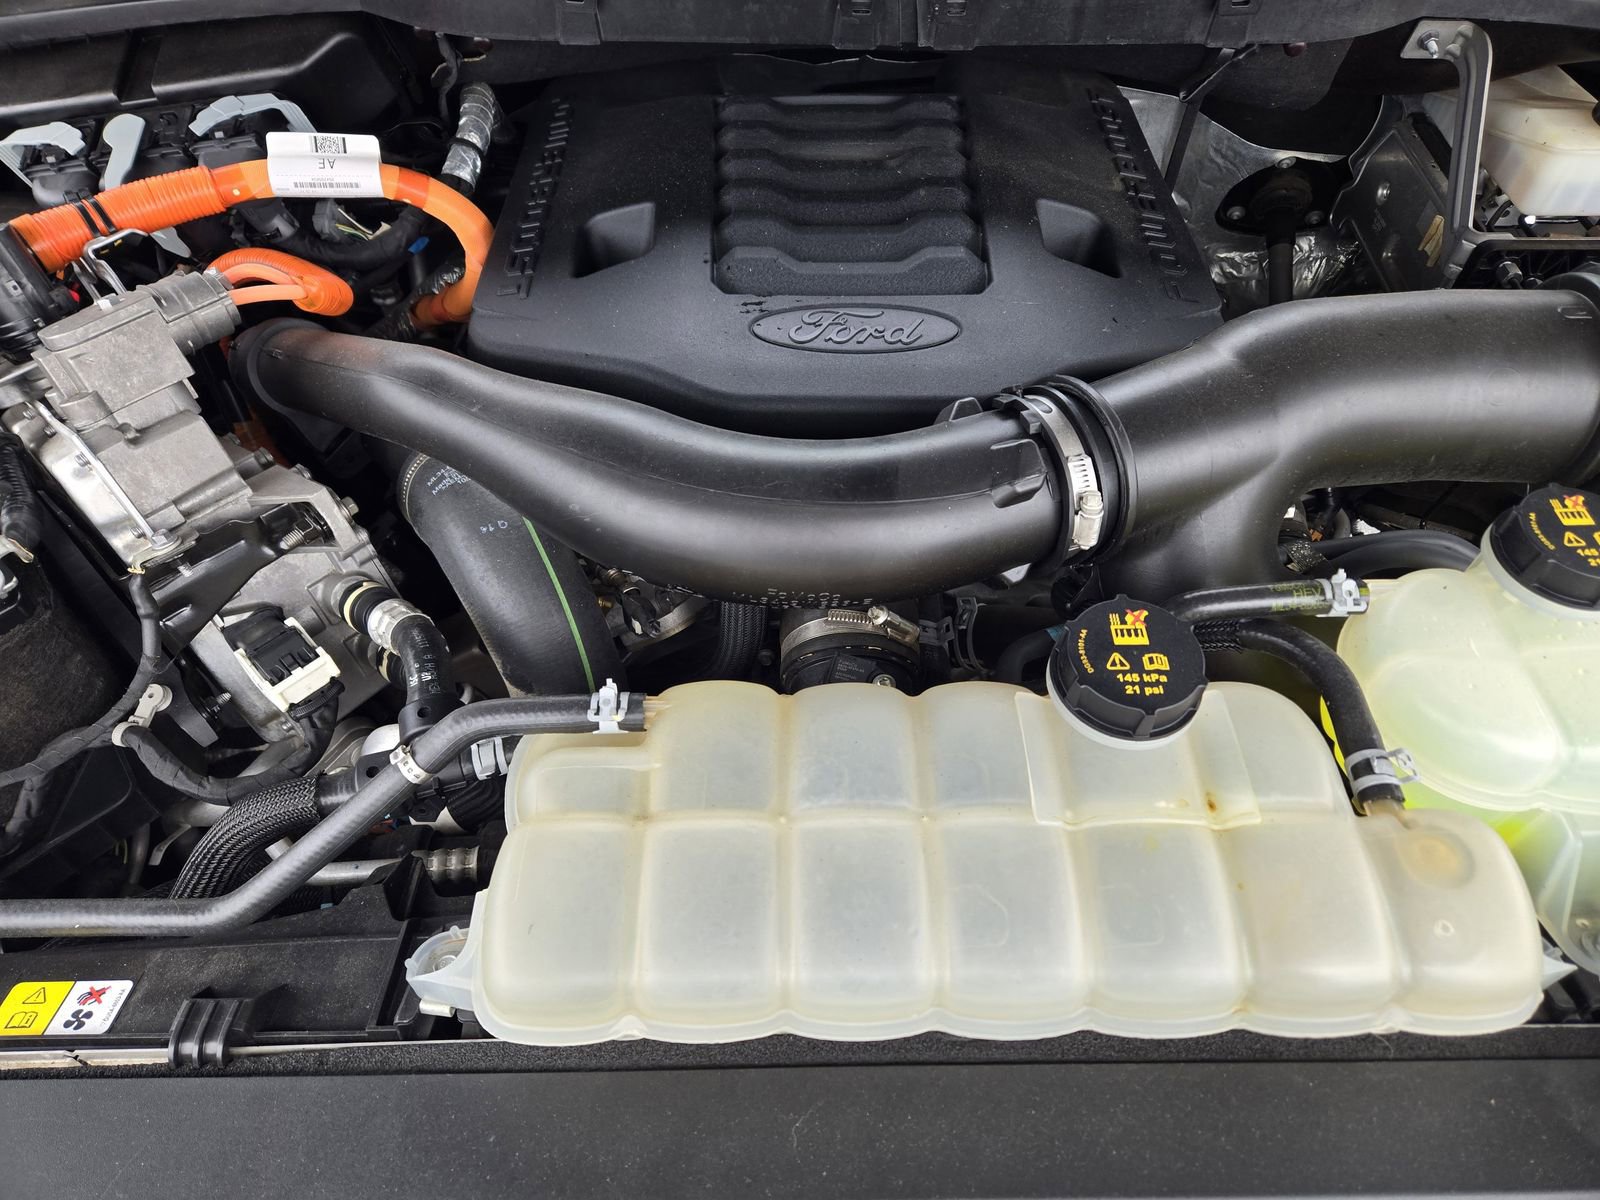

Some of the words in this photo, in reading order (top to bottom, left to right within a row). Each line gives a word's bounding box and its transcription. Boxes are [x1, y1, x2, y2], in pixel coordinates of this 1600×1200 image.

[788, 310, 925, 345] Ford
[1116, 673, 1140, 683] 145
[1142, 673, 1168, 683] kPa
[1125, 685, 1140, 695] 21
[1144, 685, 1164, 696] psi
